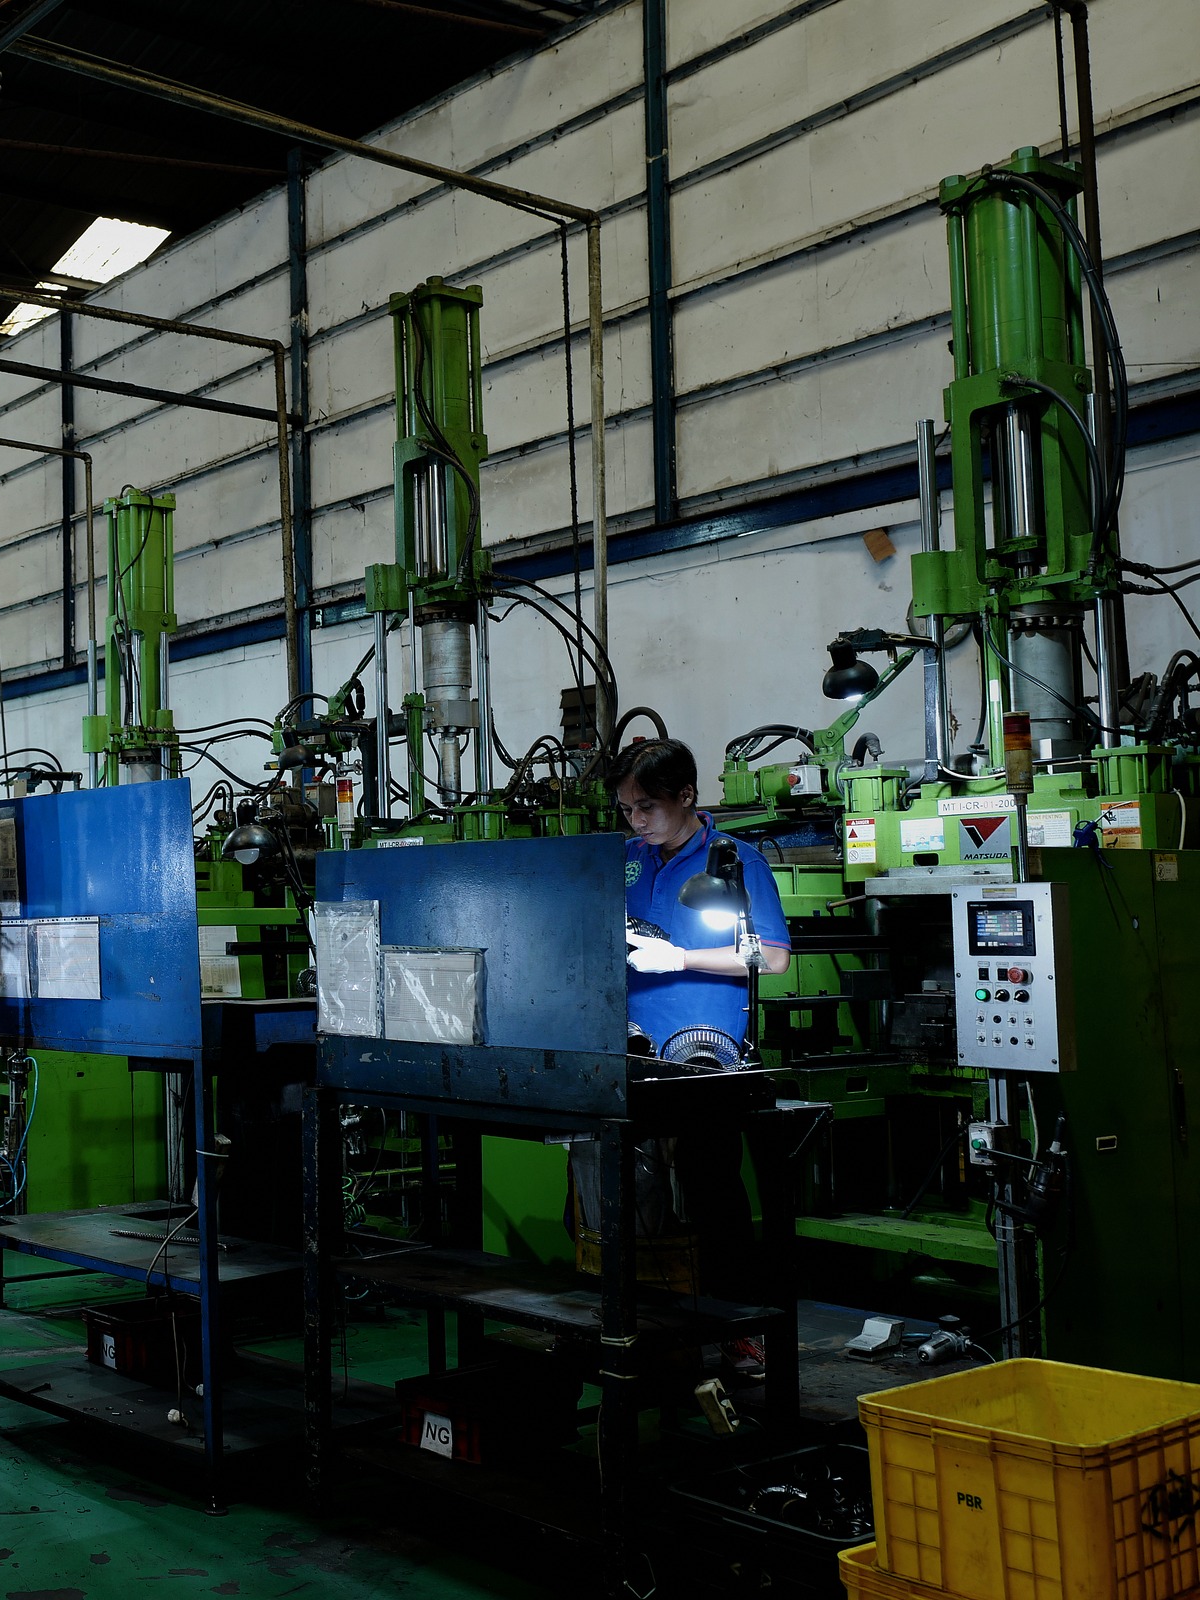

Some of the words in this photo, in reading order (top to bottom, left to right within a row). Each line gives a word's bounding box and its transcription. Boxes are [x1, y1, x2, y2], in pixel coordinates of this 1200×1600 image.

[942, 803, 956, 812] MT
[964, 852, 1009, 860] MATSUDA
[100, 1342, 116, 1360] NG
[425, 1421, 450, 1446] NG
[956, 1491, 983, 1510] PBR
